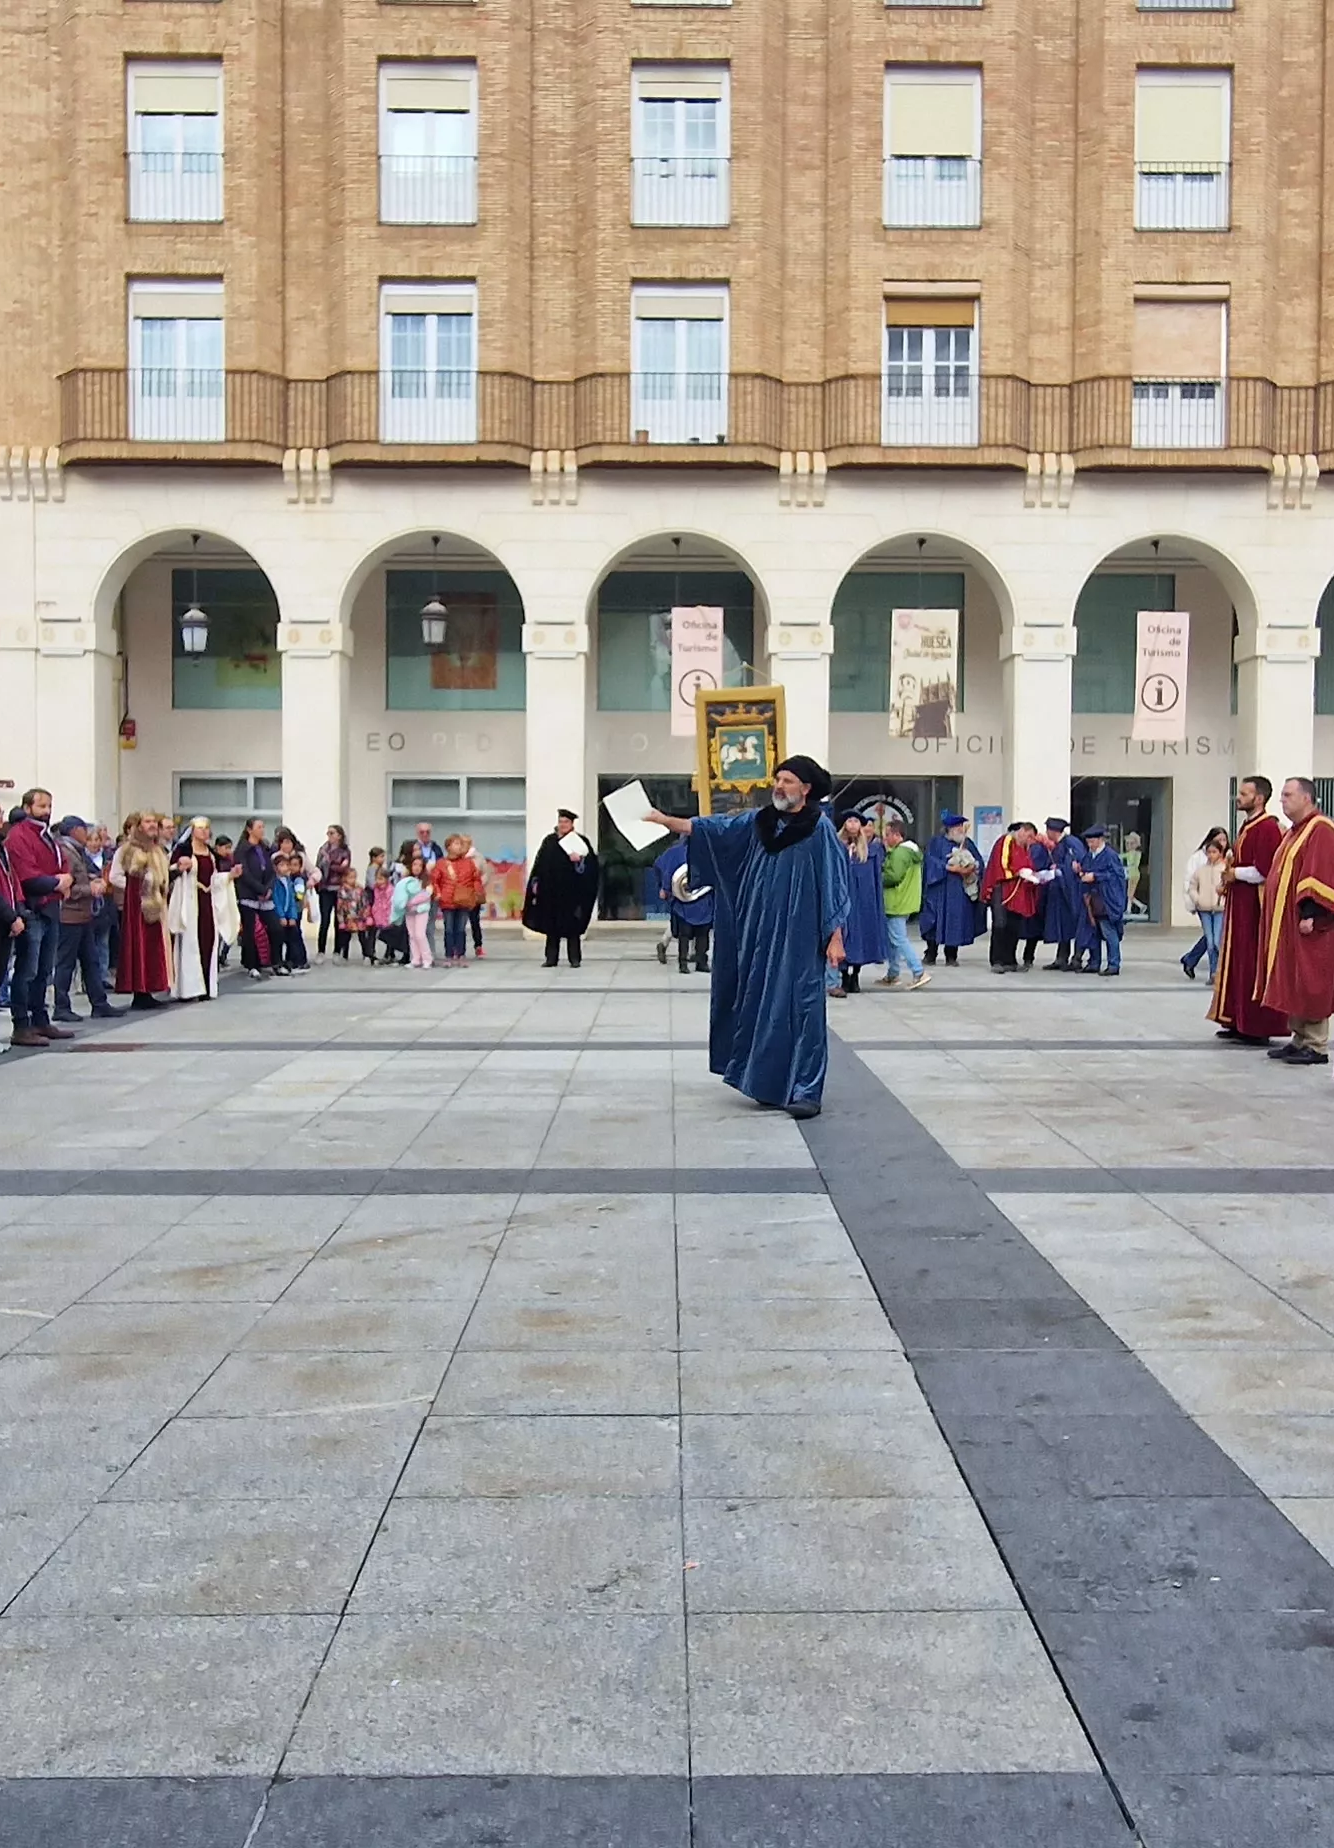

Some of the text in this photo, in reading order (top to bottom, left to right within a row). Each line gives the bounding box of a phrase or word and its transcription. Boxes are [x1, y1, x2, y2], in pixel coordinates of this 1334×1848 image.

[682, 620, 718, 630] Oficina
[1147, 624, 1182, 635] Oficina
[1169, 637, 1181, 646] de
[677, 643, 718, 653] Turismo
[1142, 647, 1181, 657] Turismo
[911, 735, 1004, 753] OFICI
